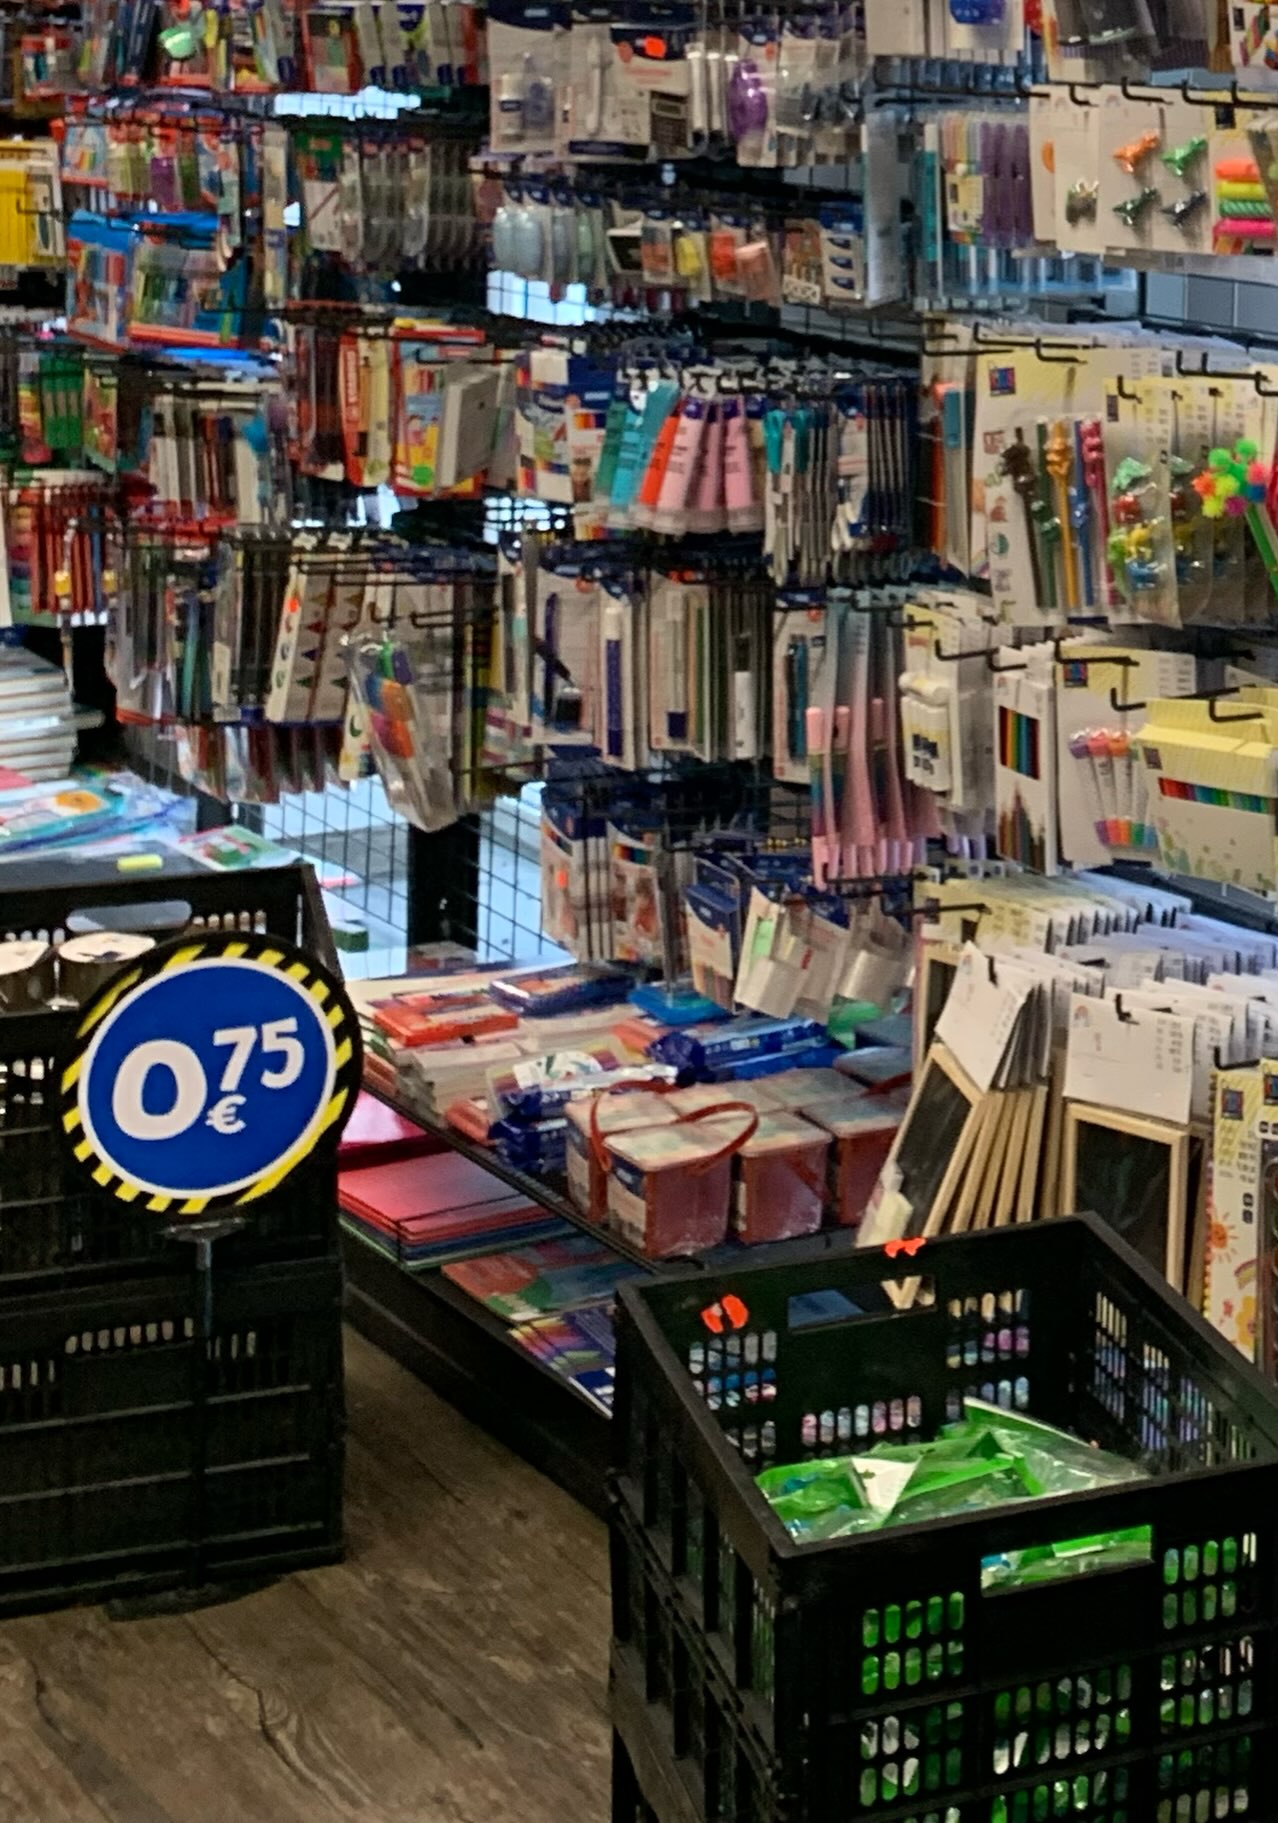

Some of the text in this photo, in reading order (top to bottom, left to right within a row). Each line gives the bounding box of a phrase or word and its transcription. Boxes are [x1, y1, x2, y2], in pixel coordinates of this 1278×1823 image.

[112, 1017, 305, 1142] 0 75 €
